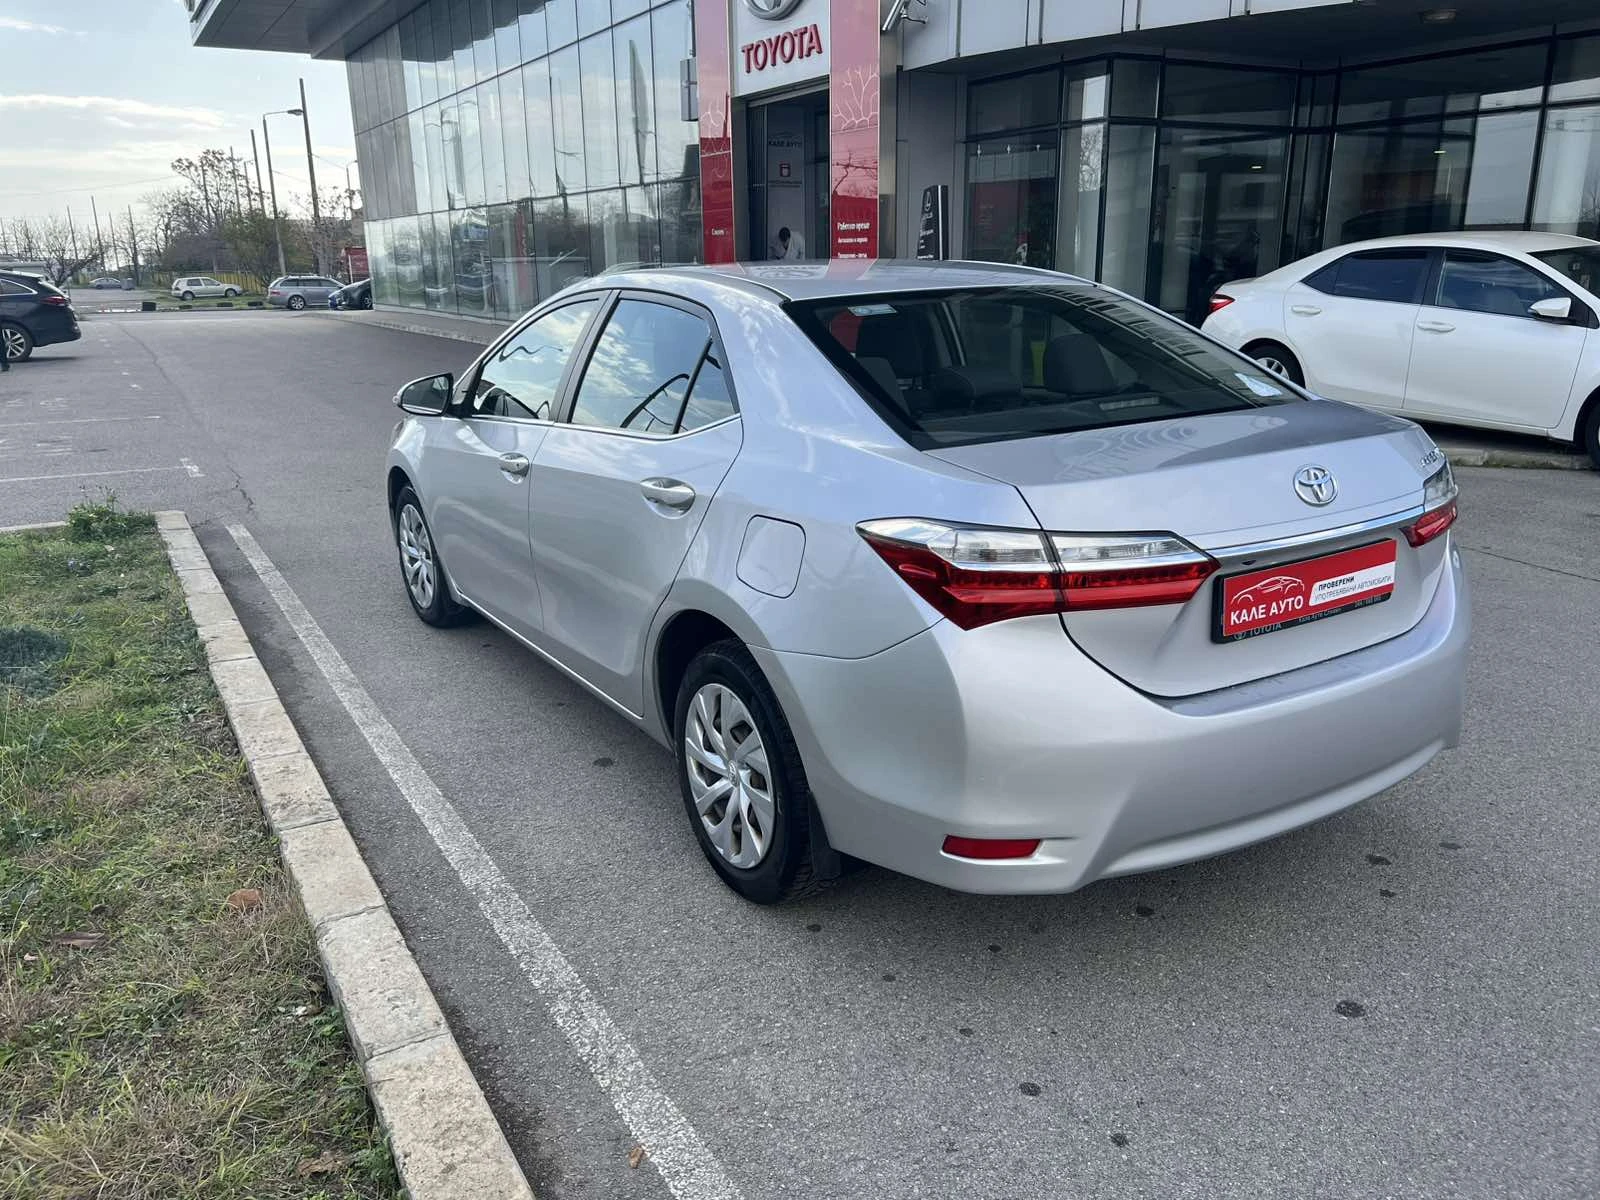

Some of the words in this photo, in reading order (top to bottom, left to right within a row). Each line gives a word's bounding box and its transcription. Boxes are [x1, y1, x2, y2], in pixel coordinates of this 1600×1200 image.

[741, 23, 823, 74] TOYOTA
[1314, 585, 1356, 602] УПОТРЕБЯВАНИ
[1357, 575, 1392, 593] АВТОМОБИЛИ
[1318, 575, 1355, 591] ПРОВЕРЕНИ
[1230, 604, 1266, 626] КАЛЕ
[1269, 595, 1304, 617] АУТО
[1249, 621, 1283, 636] TOYOTA
